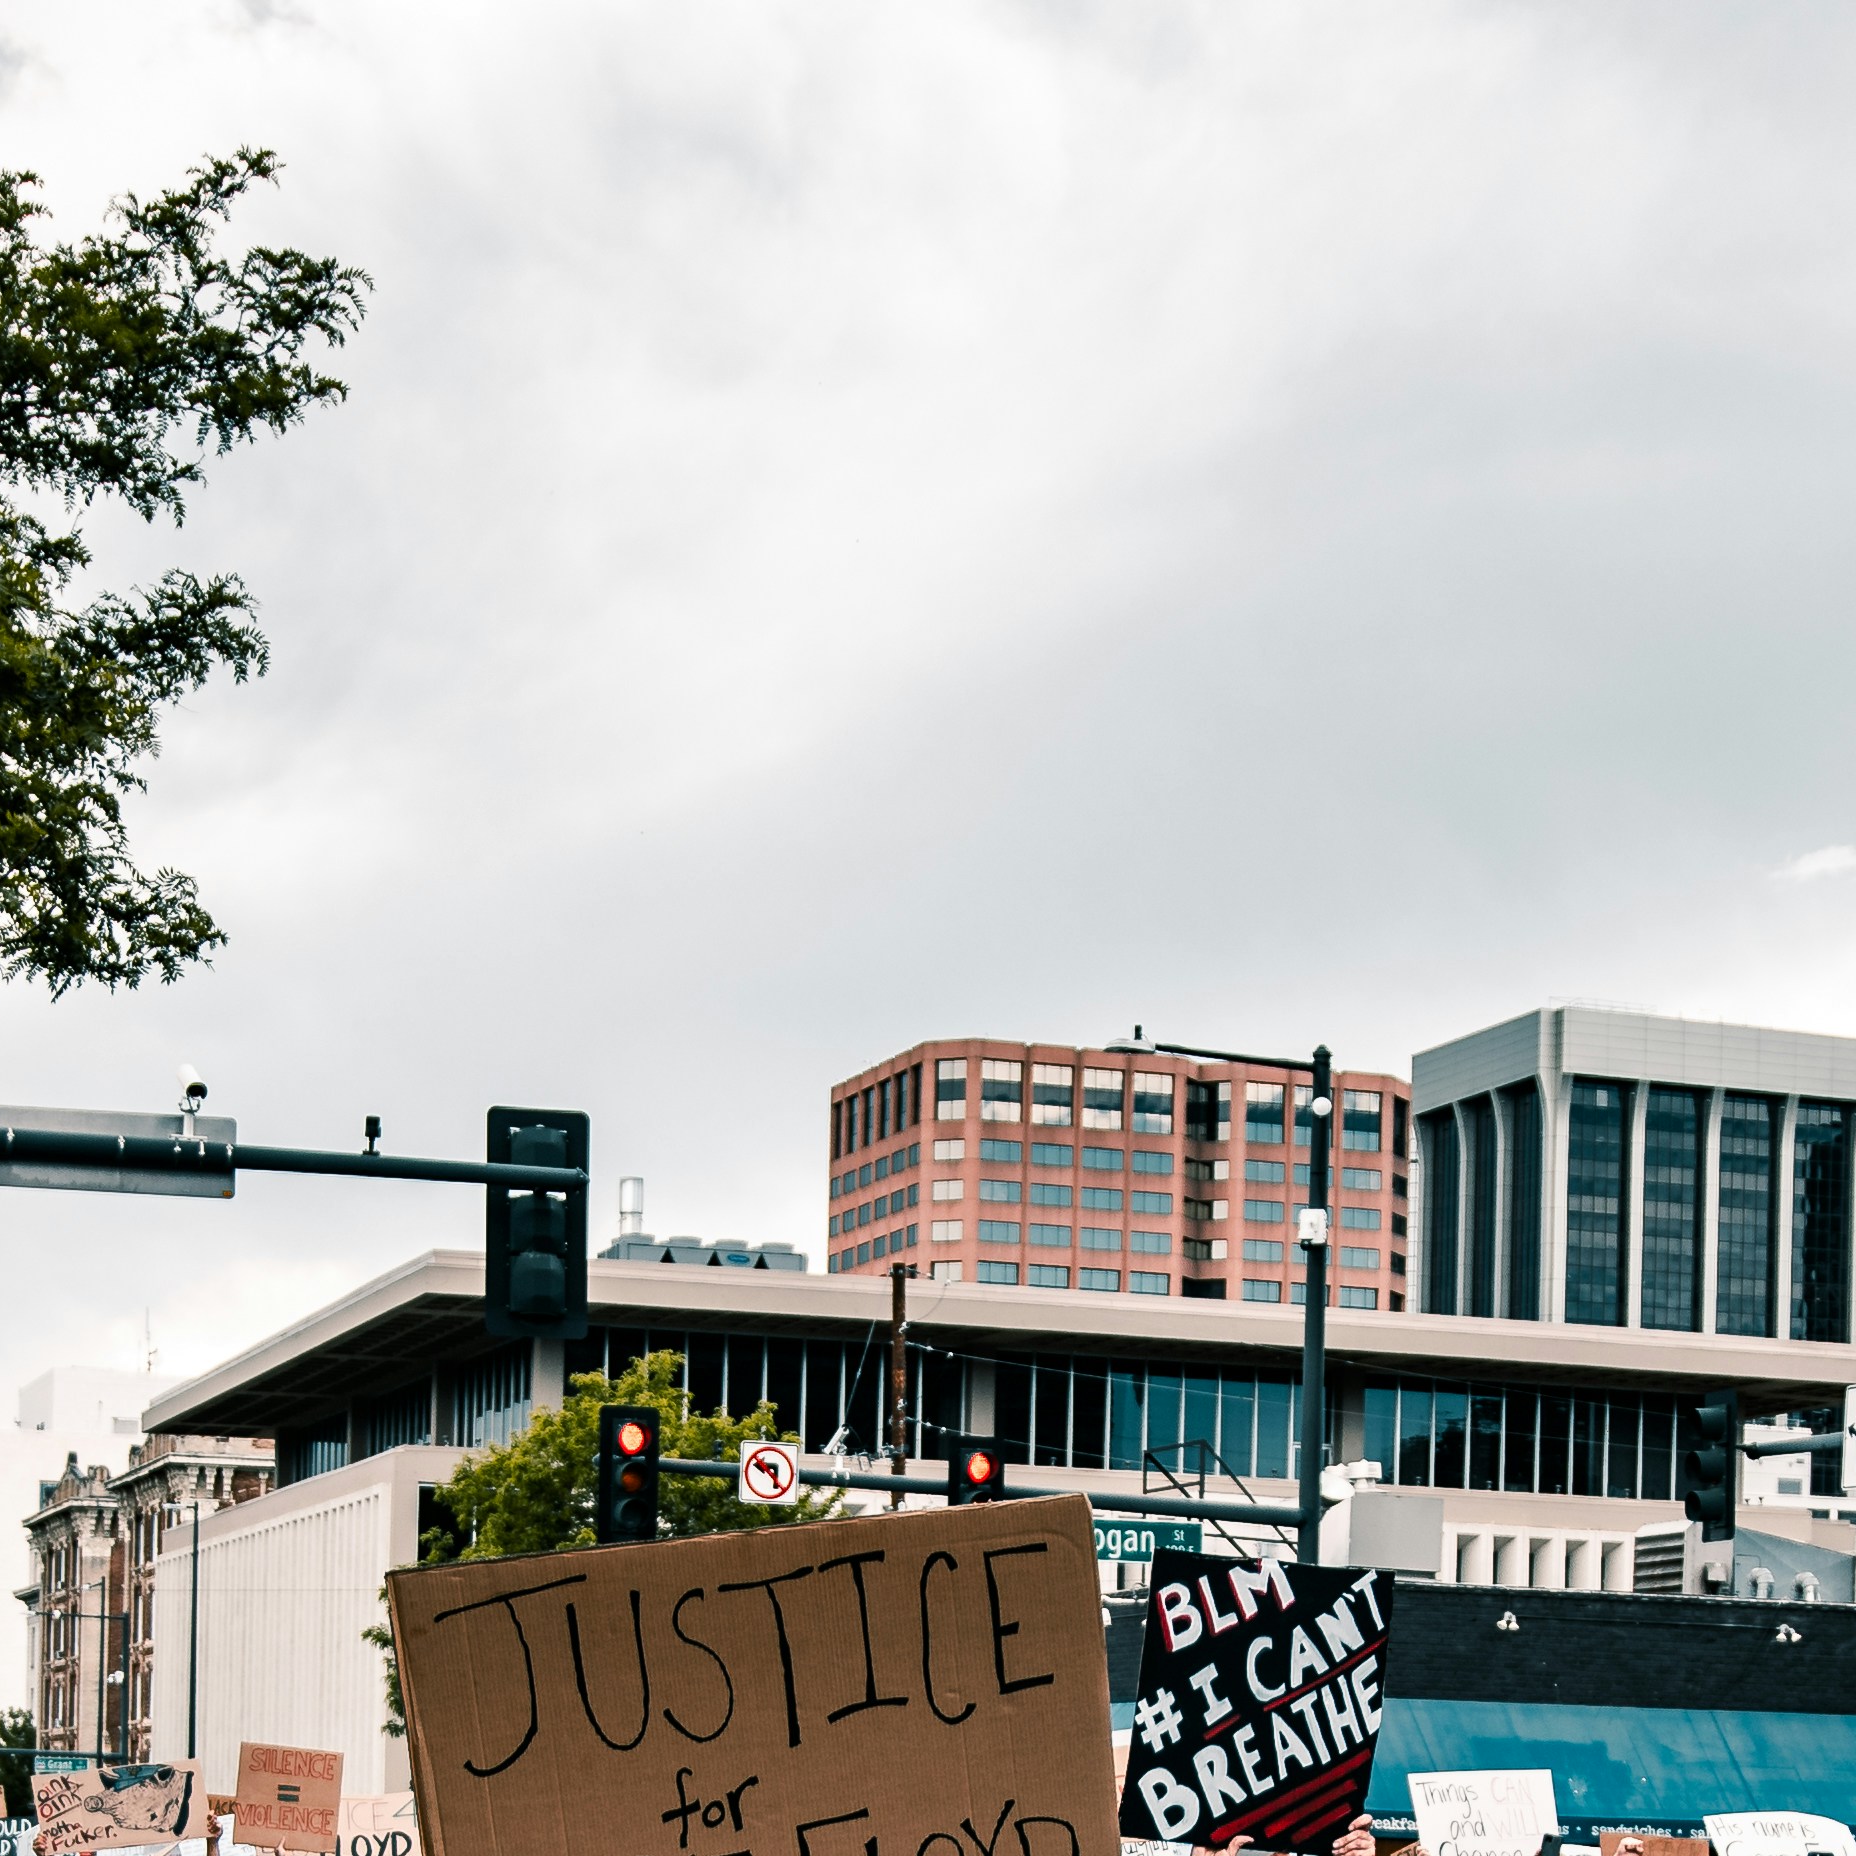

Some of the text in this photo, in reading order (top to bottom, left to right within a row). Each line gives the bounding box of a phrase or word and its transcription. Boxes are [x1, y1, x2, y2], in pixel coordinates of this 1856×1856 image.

[1093, 1527, 1185, 1560] ogan St
[1156, 1559, 1296, 1654] BLM
[1245, 1567, 1386, 1703] CAN'T
[433, 1541, 1056, 1778] JUSTICE
[47, 1759, 73, 1769] Grant
[248, 1747, 338, 1781] SILENCE
[1137, 1654, 1383, 1842] BREATHE
[661, 1767, 760, 1849] for
[1415, 1780, 1479, 1819] Things
[233, 1801, 335, 1837] VIOLENCE
[1450, 1809, 1487, 1841] and
[1751, 1820, 1795, 1839] name
